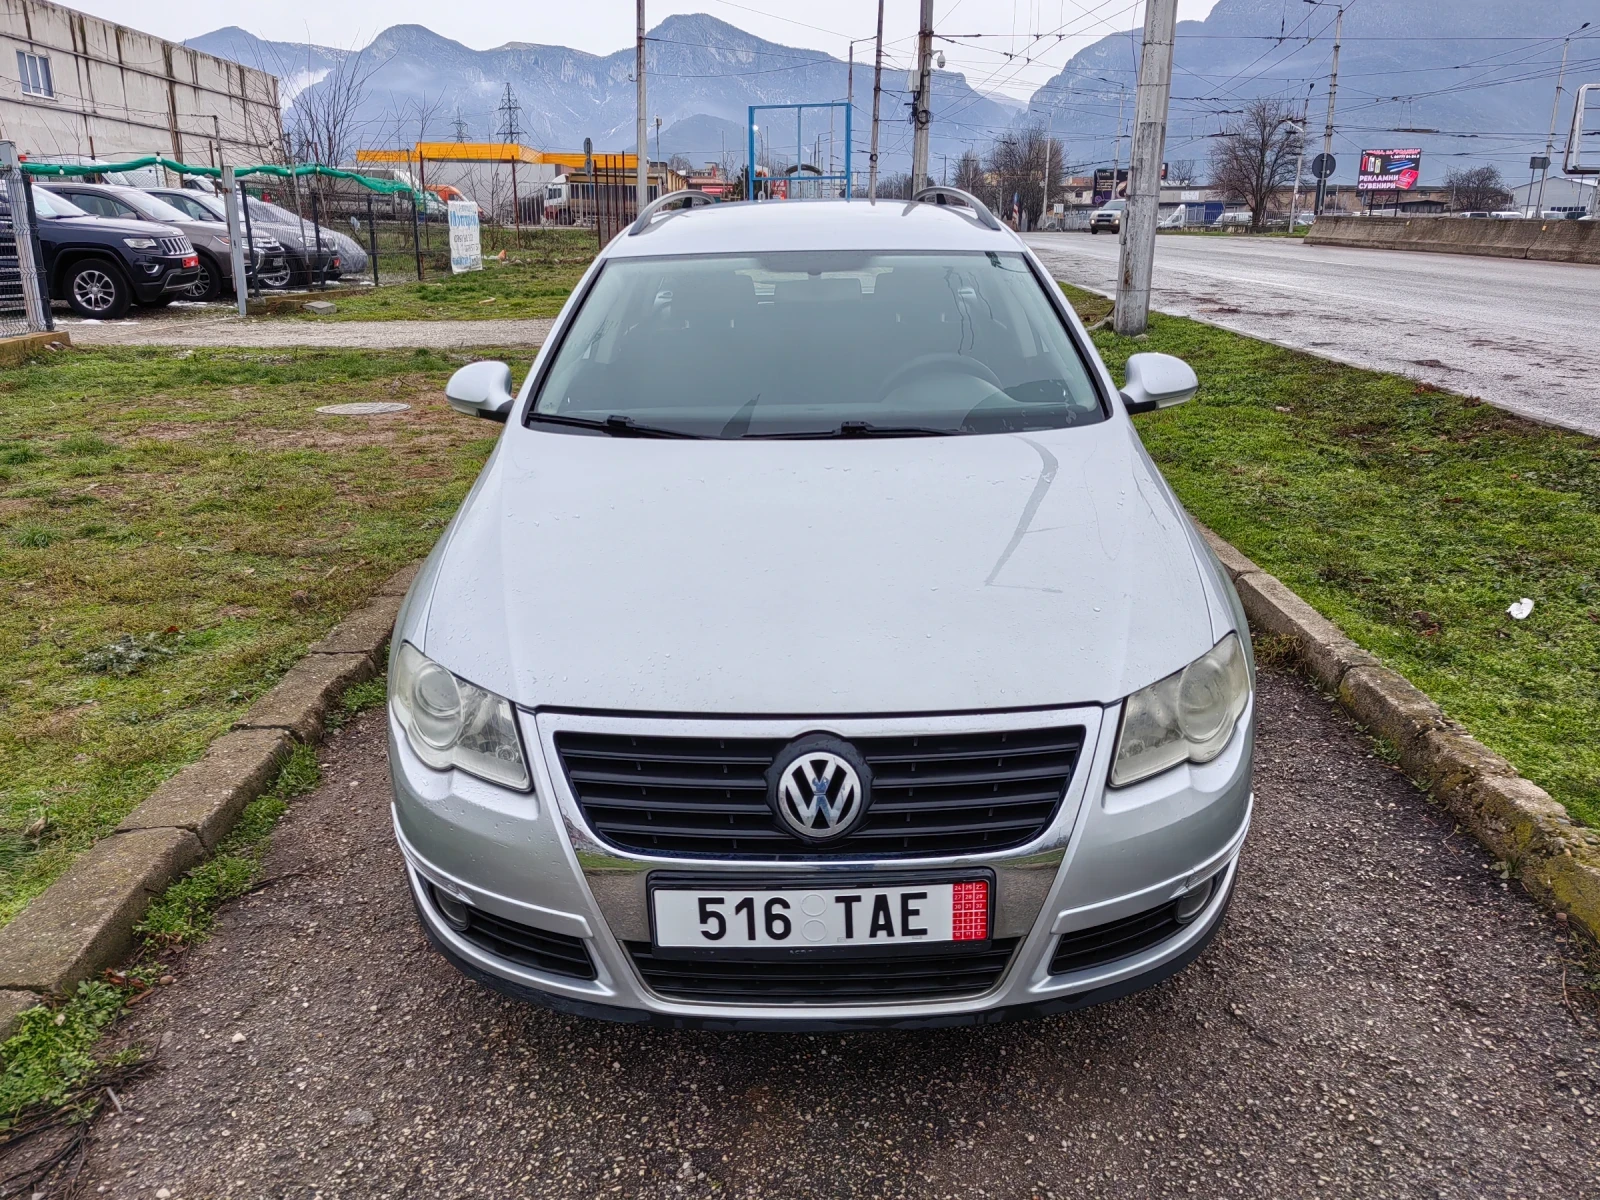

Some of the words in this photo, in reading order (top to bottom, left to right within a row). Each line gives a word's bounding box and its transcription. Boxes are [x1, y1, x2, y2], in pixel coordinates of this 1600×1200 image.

[1359, 174, 1399, 182] РЕКЛАМНИ
[698, 896, 792, 941] 516
[834, 891, 928, 939] TAE
